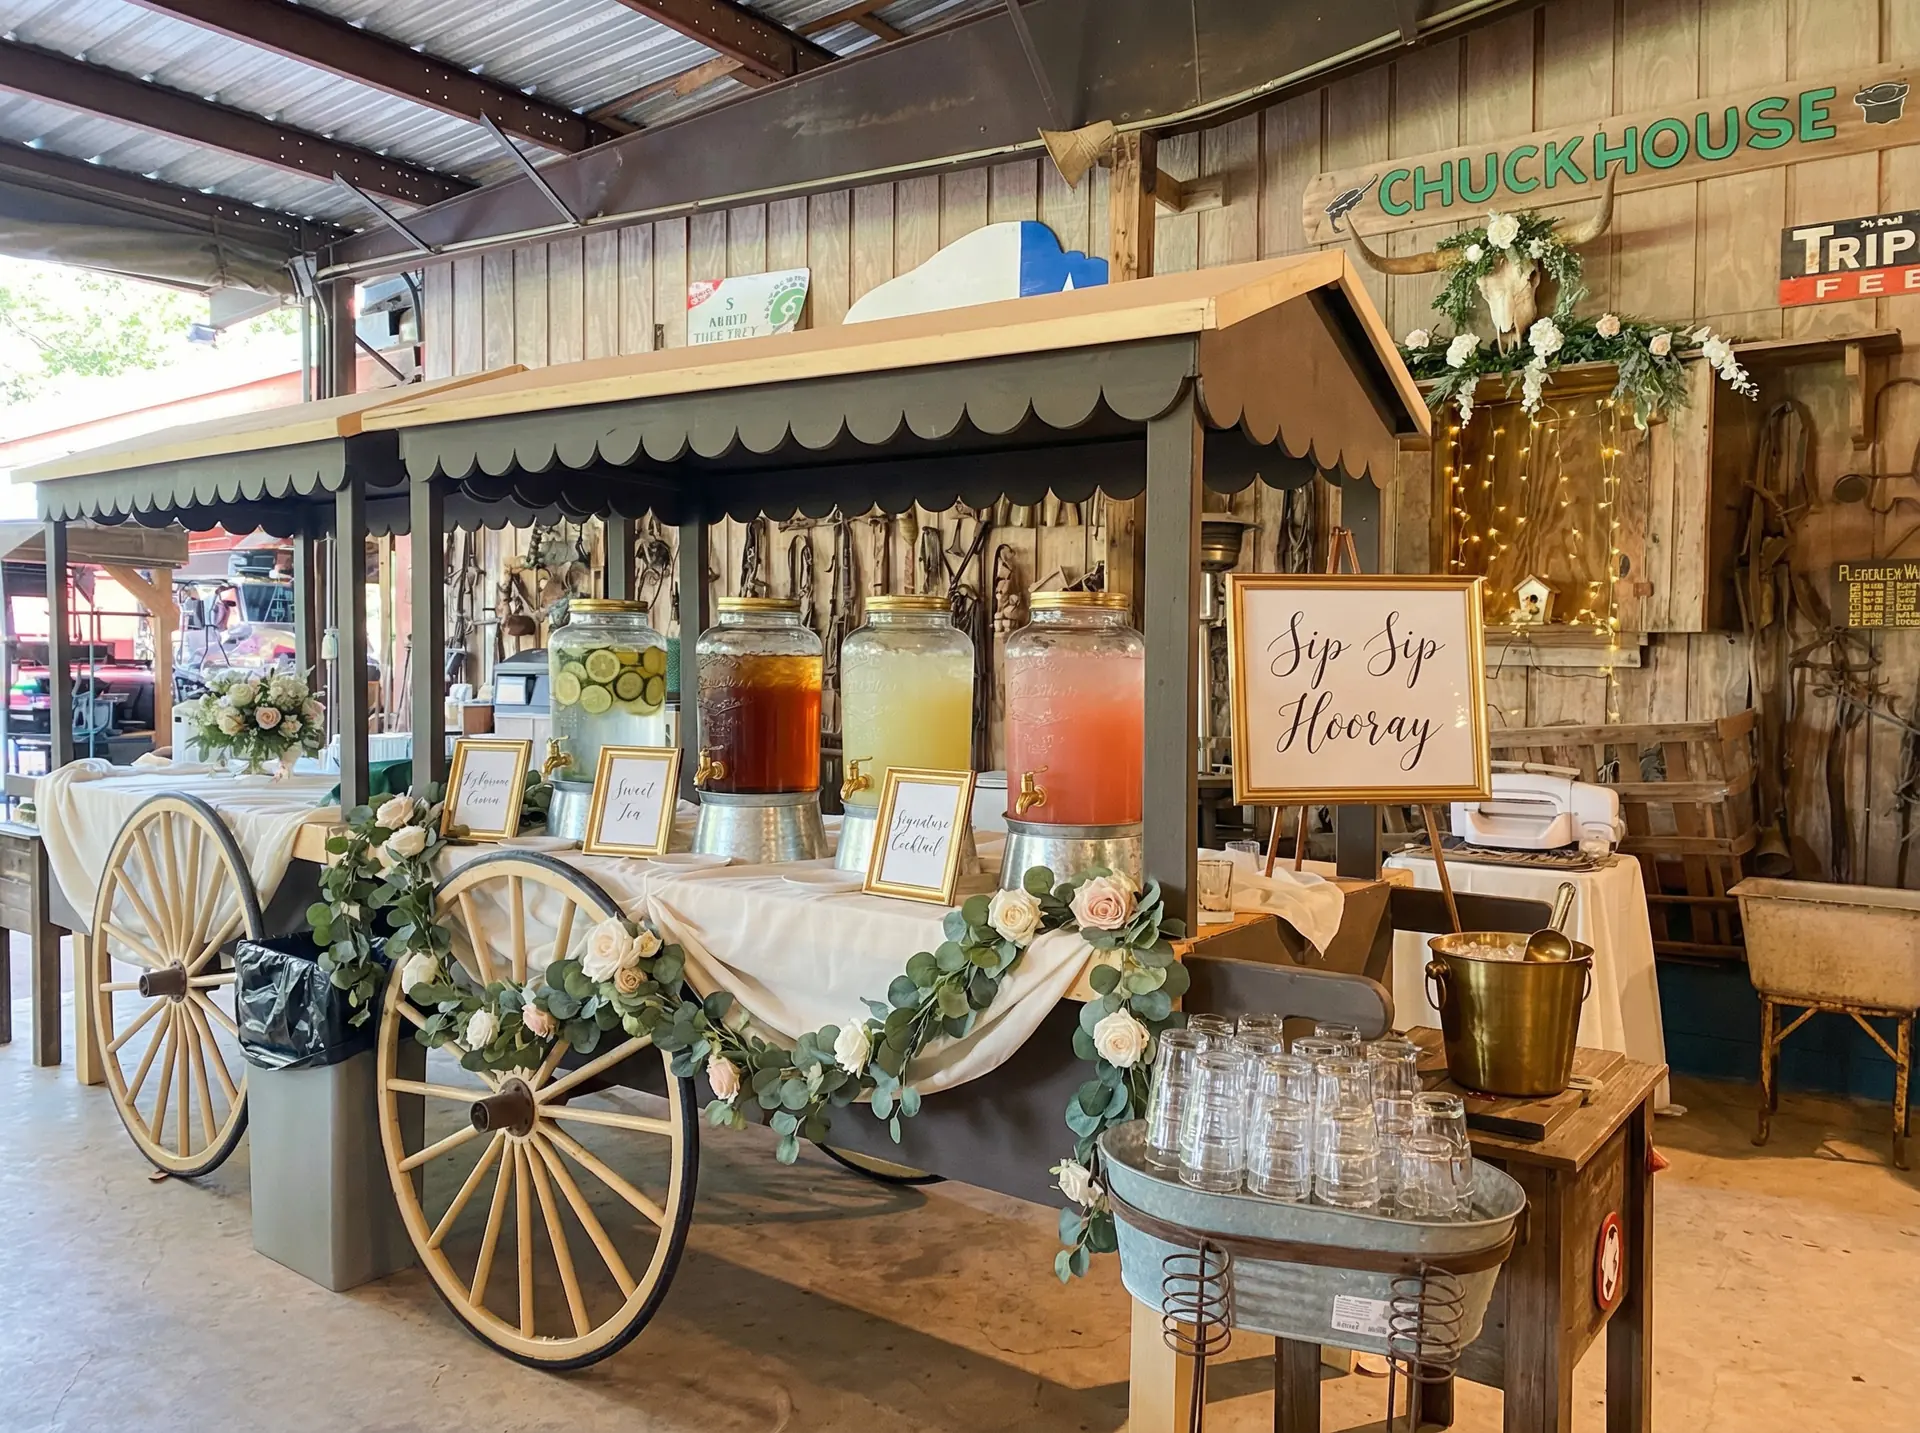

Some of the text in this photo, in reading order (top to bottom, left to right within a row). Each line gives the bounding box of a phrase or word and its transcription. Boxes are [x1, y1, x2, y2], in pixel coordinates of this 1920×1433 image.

[1378, 86, 1838, 216] CHUCKHOUSE
[1792, 224, 1920, 275] TRIP
[1816, 268, 1920, 298] FEE
[1266, 610, 1446, 690] Sip Sip
[1276, 690, 1444, 771] Hooray
[611, 777, 655, 801] Sweet
[616, 802, 644, 822] Tea
[892, 808, 950, 834] Signature
[891, 832, 944, 857] Cocktail
